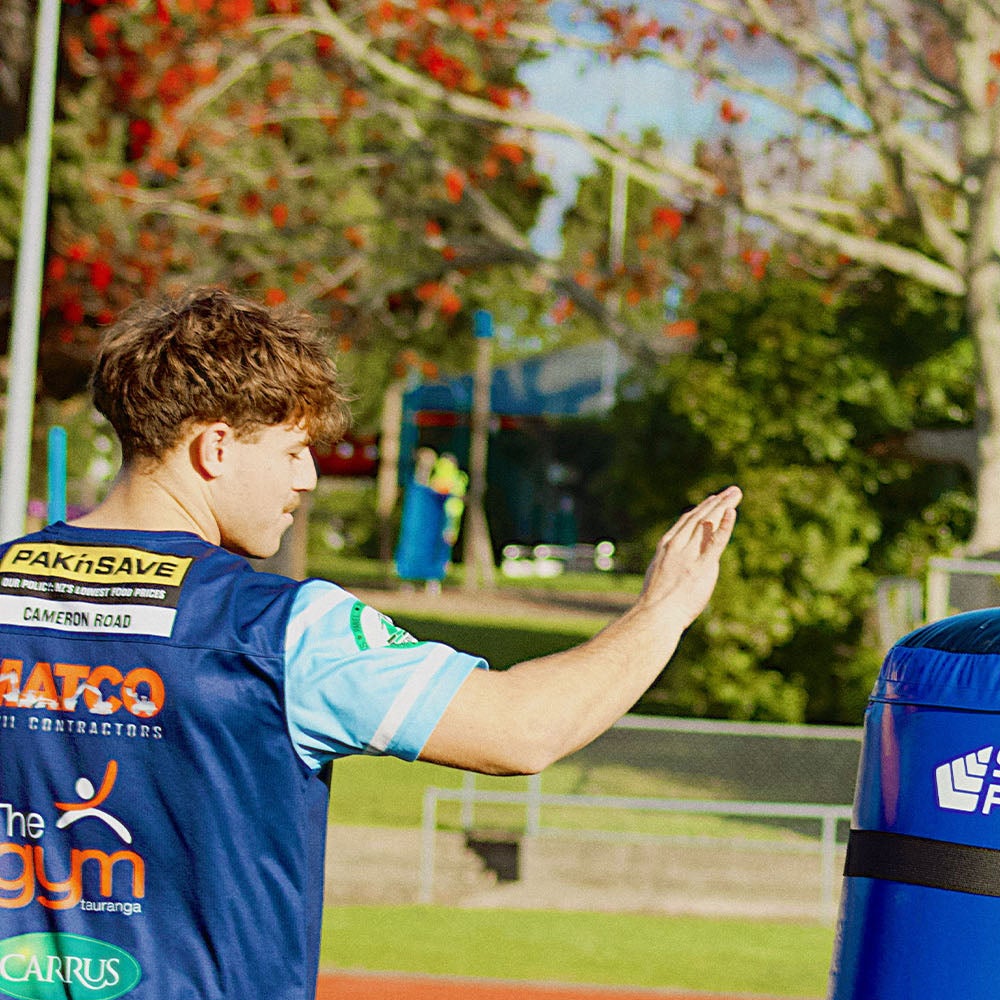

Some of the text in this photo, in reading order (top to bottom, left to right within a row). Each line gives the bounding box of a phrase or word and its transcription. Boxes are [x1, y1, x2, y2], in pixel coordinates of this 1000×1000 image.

[134, 588, 166, 600] PRICES
[23, 607, 131, 628] CAMERON ROAD
[28, 716, 162, 739] CONTRACTORS
[0, 842, 145, 910] gym
[80, 899, 142, 915] tauranga
[0, 954, 120, 990] CARRUS
